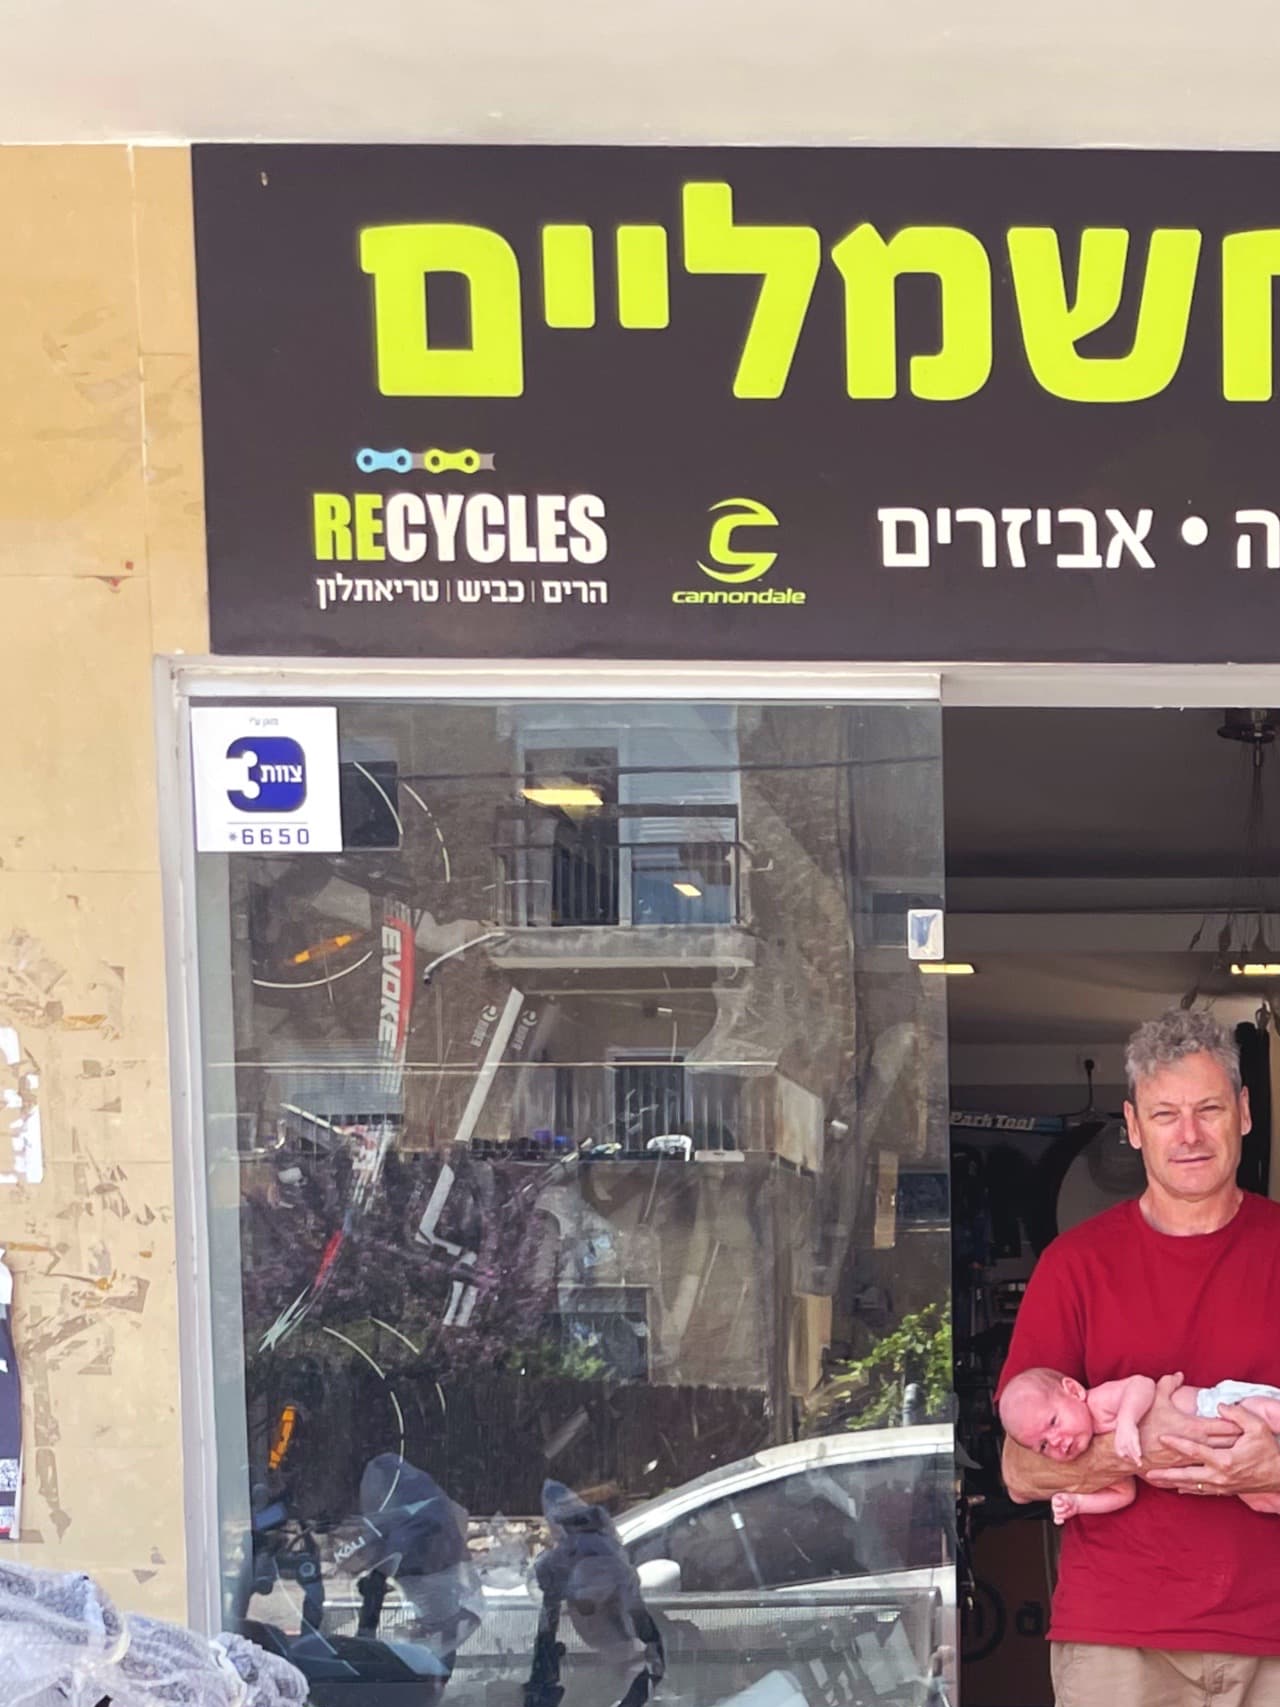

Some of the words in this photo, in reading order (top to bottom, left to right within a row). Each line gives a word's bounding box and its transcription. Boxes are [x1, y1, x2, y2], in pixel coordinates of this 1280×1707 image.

[314, 492, 608, 565] RECYCLES
[878, 508, 1157, 570] אביזרים
[316, 573, 439, 610] טריאתלון
[457, 579, 525, 603] כביש
[542, 580, 608, 604] הרים
[672, 588, 807, 605] cannondale
[260, 764, 303, 783] צוות
